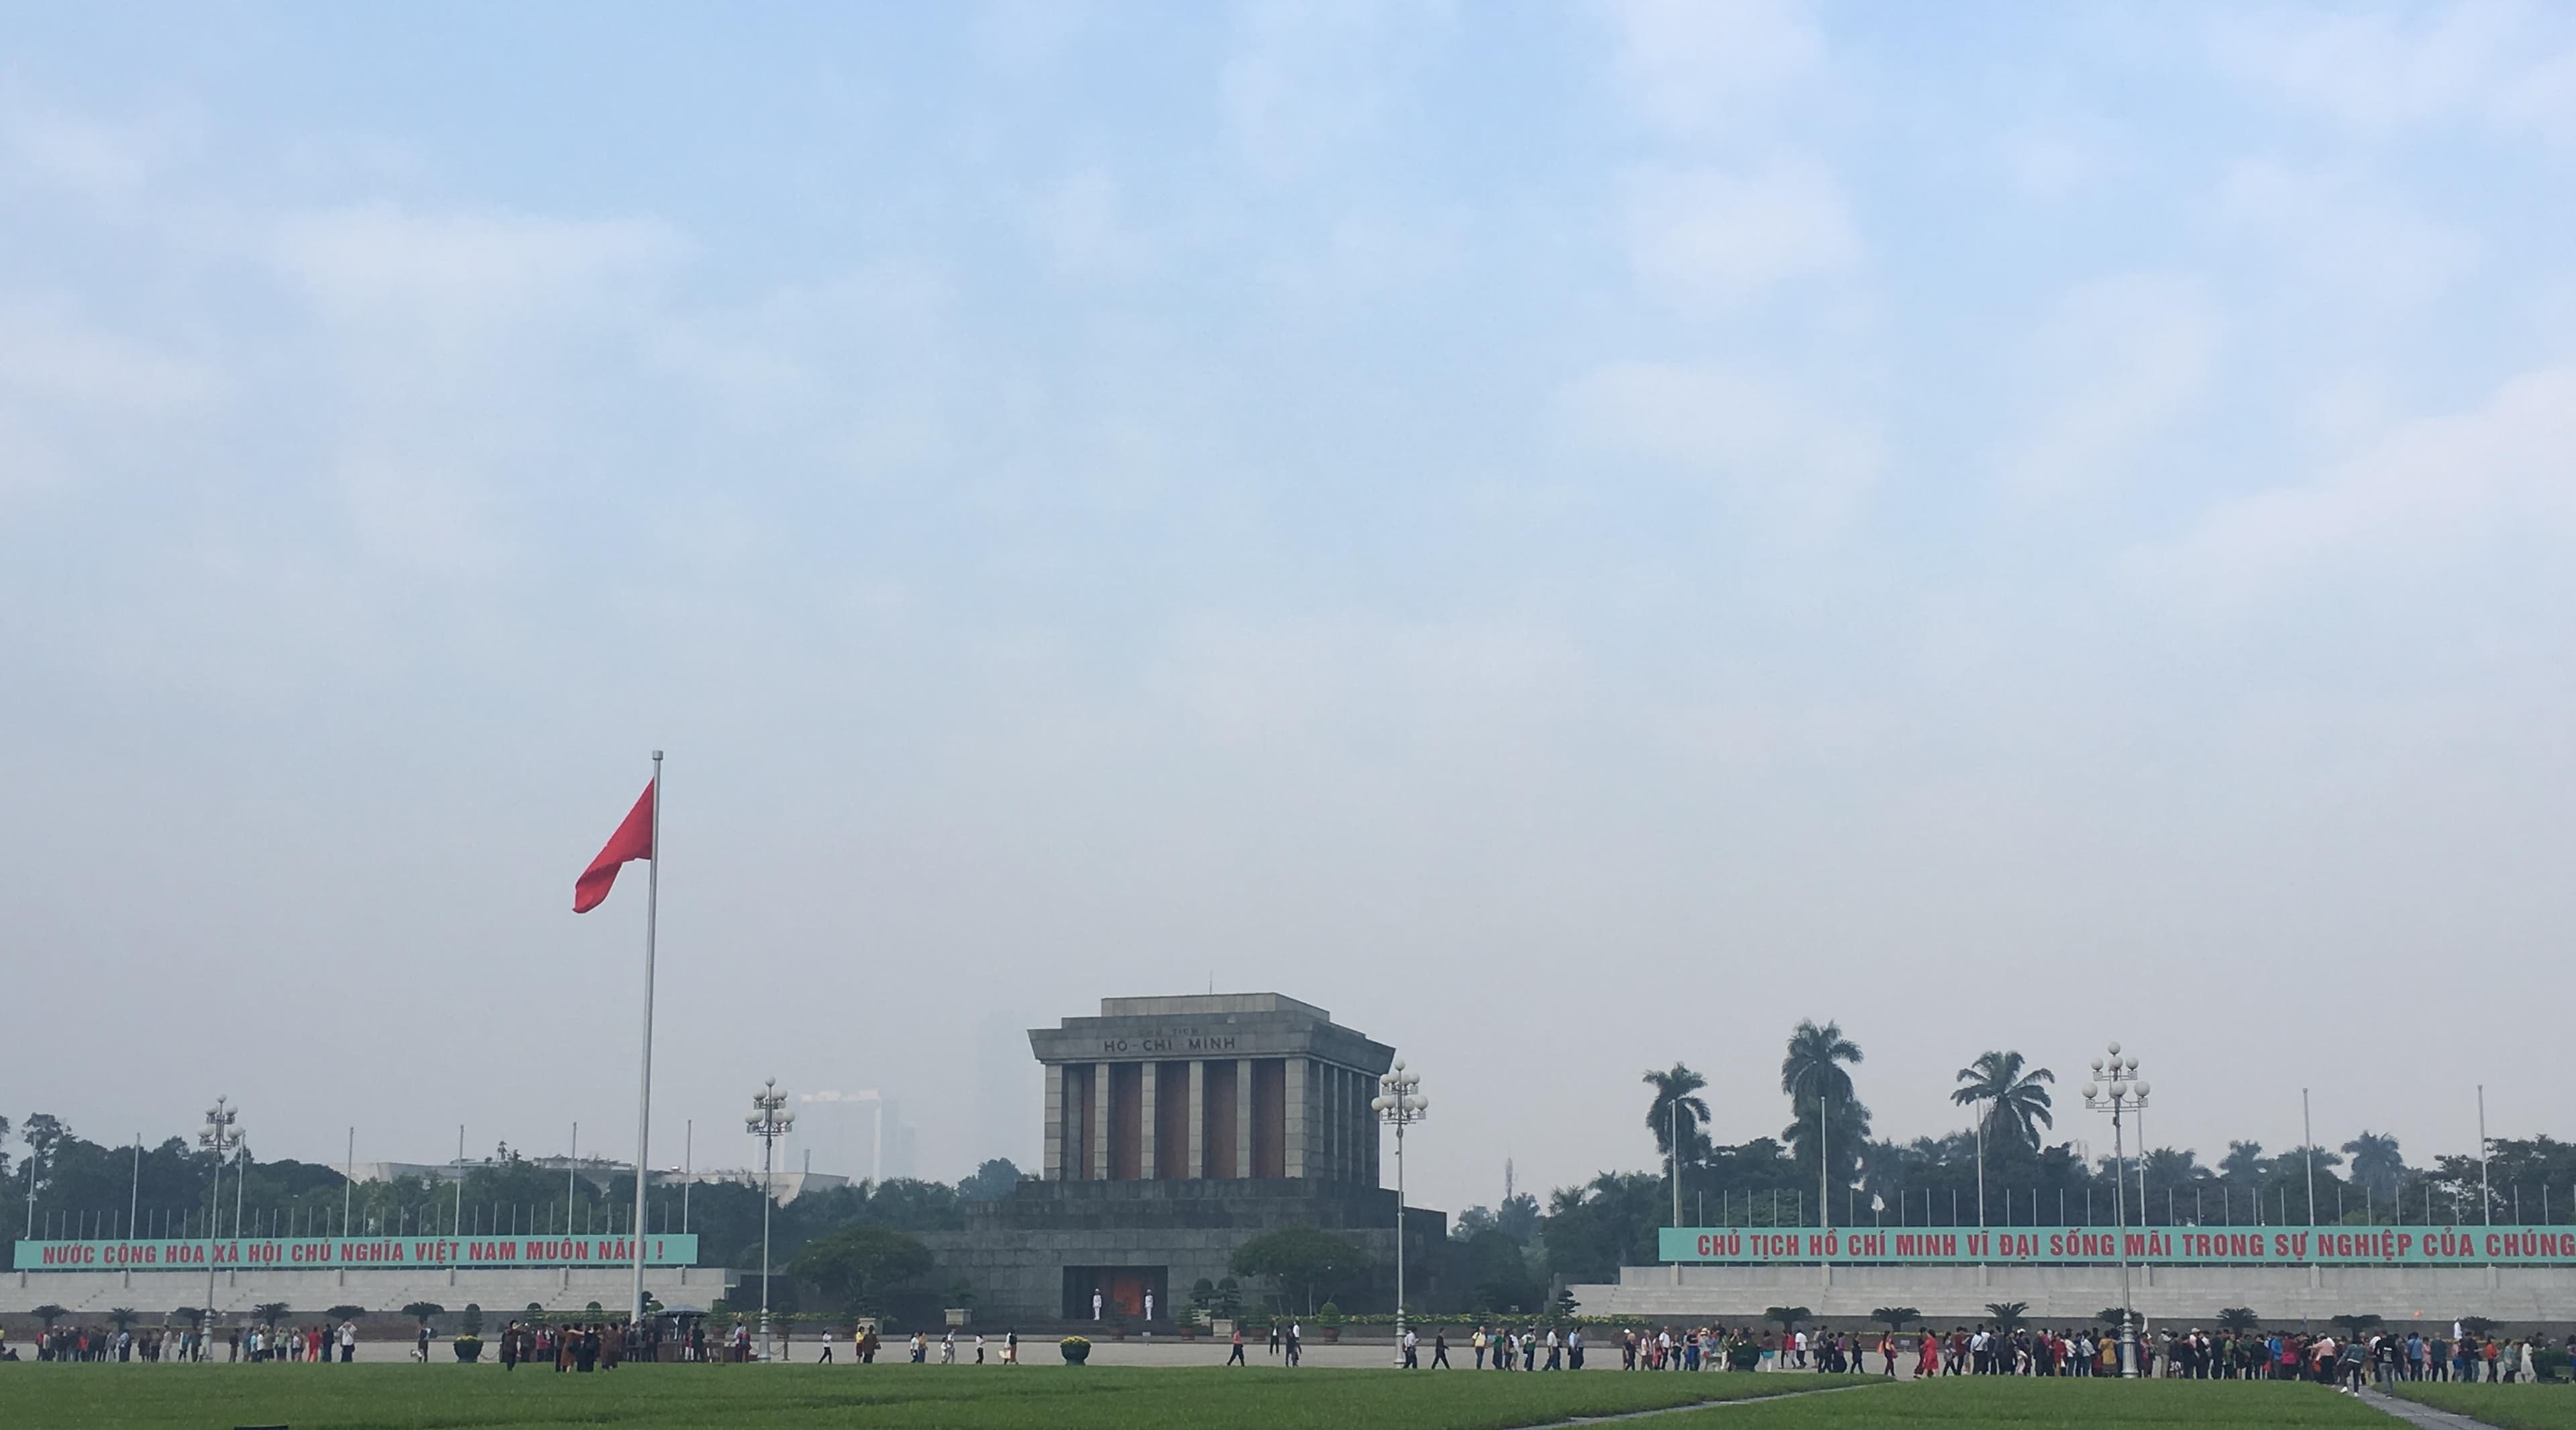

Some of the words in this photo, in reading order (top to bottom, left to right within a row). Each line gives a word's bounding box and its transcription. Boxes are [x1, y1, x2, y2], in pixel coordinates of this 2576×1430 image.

[1188, 1037, 1234, 1050] MINH
[43, 1242, 95, 1264] NƯỚC
[103, 1242, 157, 1266] CỘNG
[165, 1242, 205, 1264] HÒA
[213, 1241, 239, 1263] XÃ
[248, 1241, 282, 1266] HỘI
[291, 1238, 332, 1262] CHỦ
[341, 1240, 404, 1262] NGHĨA
[415, 1239, 460, 1264] VIỆT
[470, 1242, 516, 1260] NAM
[526, 1238, 589, 1260] MUÔN
[1697, 1228, 1741, 1256] CHỦ
[1750, 1234, 1799, 1260] TỊCH
[1809, 1228, 1838, 1256] HỒ
[1848, 1229, 1886, 1256] CHÍ
[1896, 1234, 1957, 1256] MINH
[1967, 1230, 1989, 1256] VĨ
[1999, 1234, 2039, 1260] ĐẠI
[2049, 1227, 2115, 1256] SỐNG
[2125, 1229, 2172, 1256] MÃI
[2182, 1234, 2264, 1256] TRONG
[2275, 1231, 2309, 1260] SỰ
[2318, 1229, 2412, 1260] NGHIỆP
[2422, 1227, 2475, 1256] CỦA
[2485, 1228, 2575, 1256] CHÚNG
